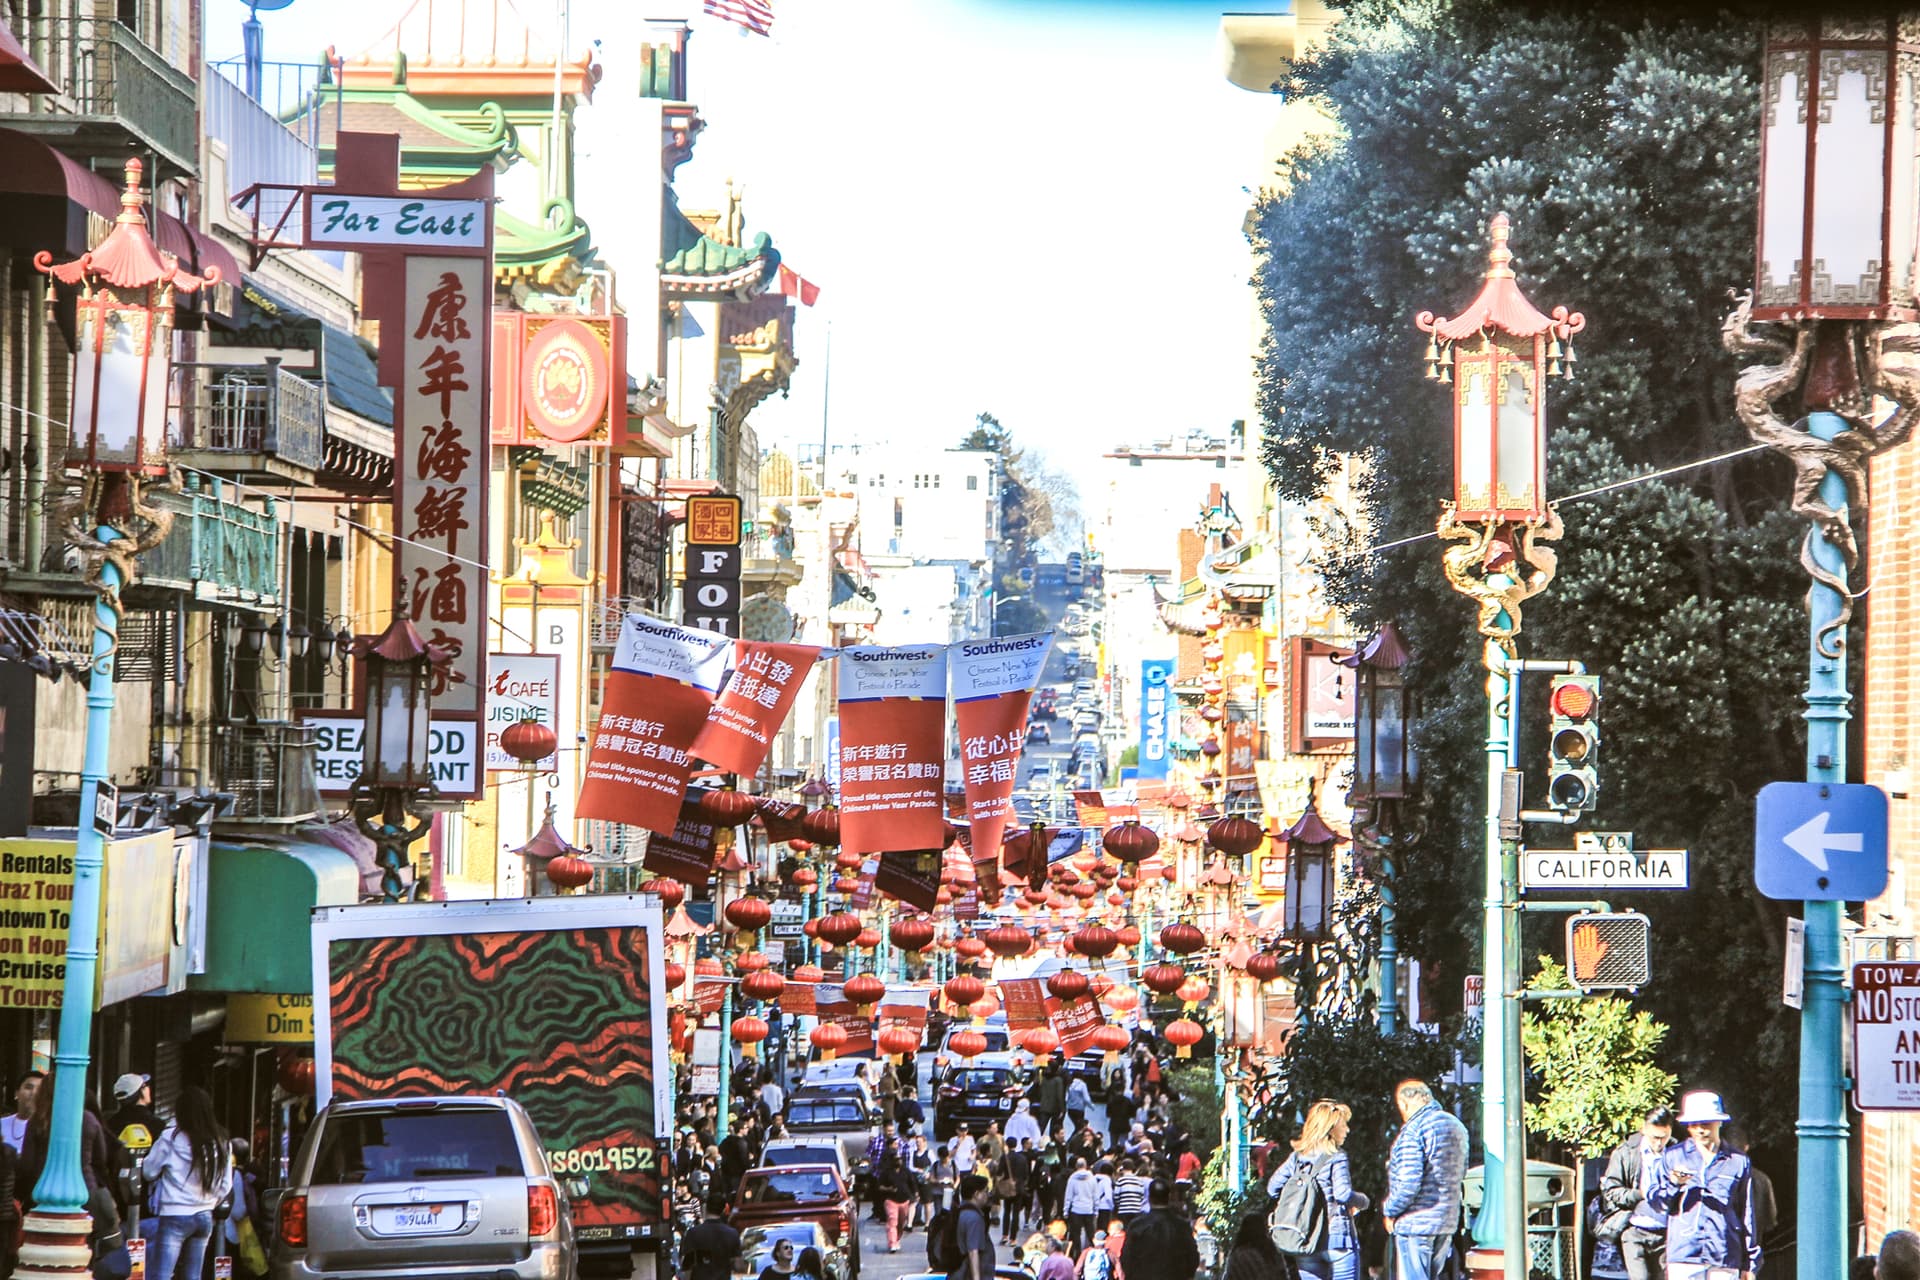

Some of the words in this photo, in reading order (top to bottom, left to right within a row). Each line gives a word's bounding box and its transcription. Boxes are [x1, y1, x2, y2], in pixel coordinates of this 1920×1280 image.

[322, 200, 380, 233] Far
[395, 203, 475, 236] East
[635, 621, 709, 647] Southwest
[666, 647, 687, 660] New
[853, 650, 927, 662] Southwest
[963, 637, 1036, 657] Southwest
[855, 667, 887, 679] Chinese
[889, 667, 908, 678] New
[909, 668, 929, 678] Year
[967, 662, 999, 678] Chinese
[1002, 660, 1021, 672] New
[1021, 657, 1040, 669] Year
[893, 680, 921, 690] Parade
[1009, 671, 1034, 684] Parade
[509, 679, 549, 697] CAFÉ
[600, 713, 665, 738] 新年遊行
[1147, 687, 1165, 760] CHASE
[843, 743, 907, 762] 新年遊行
[589, 761, 610, 770] Proud
[610, 763, 625, 772] title
[626, 766, 657, 779] sponsor
[658, 773, 667, 781] of
[667, 775, 680, 786] the
[587, 770, 613, 780] Chinese
[614, 773, 632, 784] New
[633, 777, 650, 787] Year
[651, 781, 680, 797] Parade.
[842, 794, 864, 804] Proud
[865, 792, 881, 801] title
[881, 792, 912, 803] sponsor
[913, 790, 923, 798] of
[923, 789, 937, 798] the
[972, 800, 991, 810] Start
[842, 804, 870, 814] Chinese
[872, 802, 890, 811] New
[891, 801, 908, 809] Year
[909, 799, 938, 808] Parade.
[974, 810, 991, 820] with
[992, 809, 1005, 818] our
[1599, 836, 1626, 848] 700
[2, 853, 73, 874] Rentals
[1538, 860, 1672, 878] CALIFORNIA
[28, 935, 66, 957] Hop
[1, 985, 64, 1007] Tours
[1857, 989, 1889, 1021] NO
[267, 1012, 303, 1034] Dim
